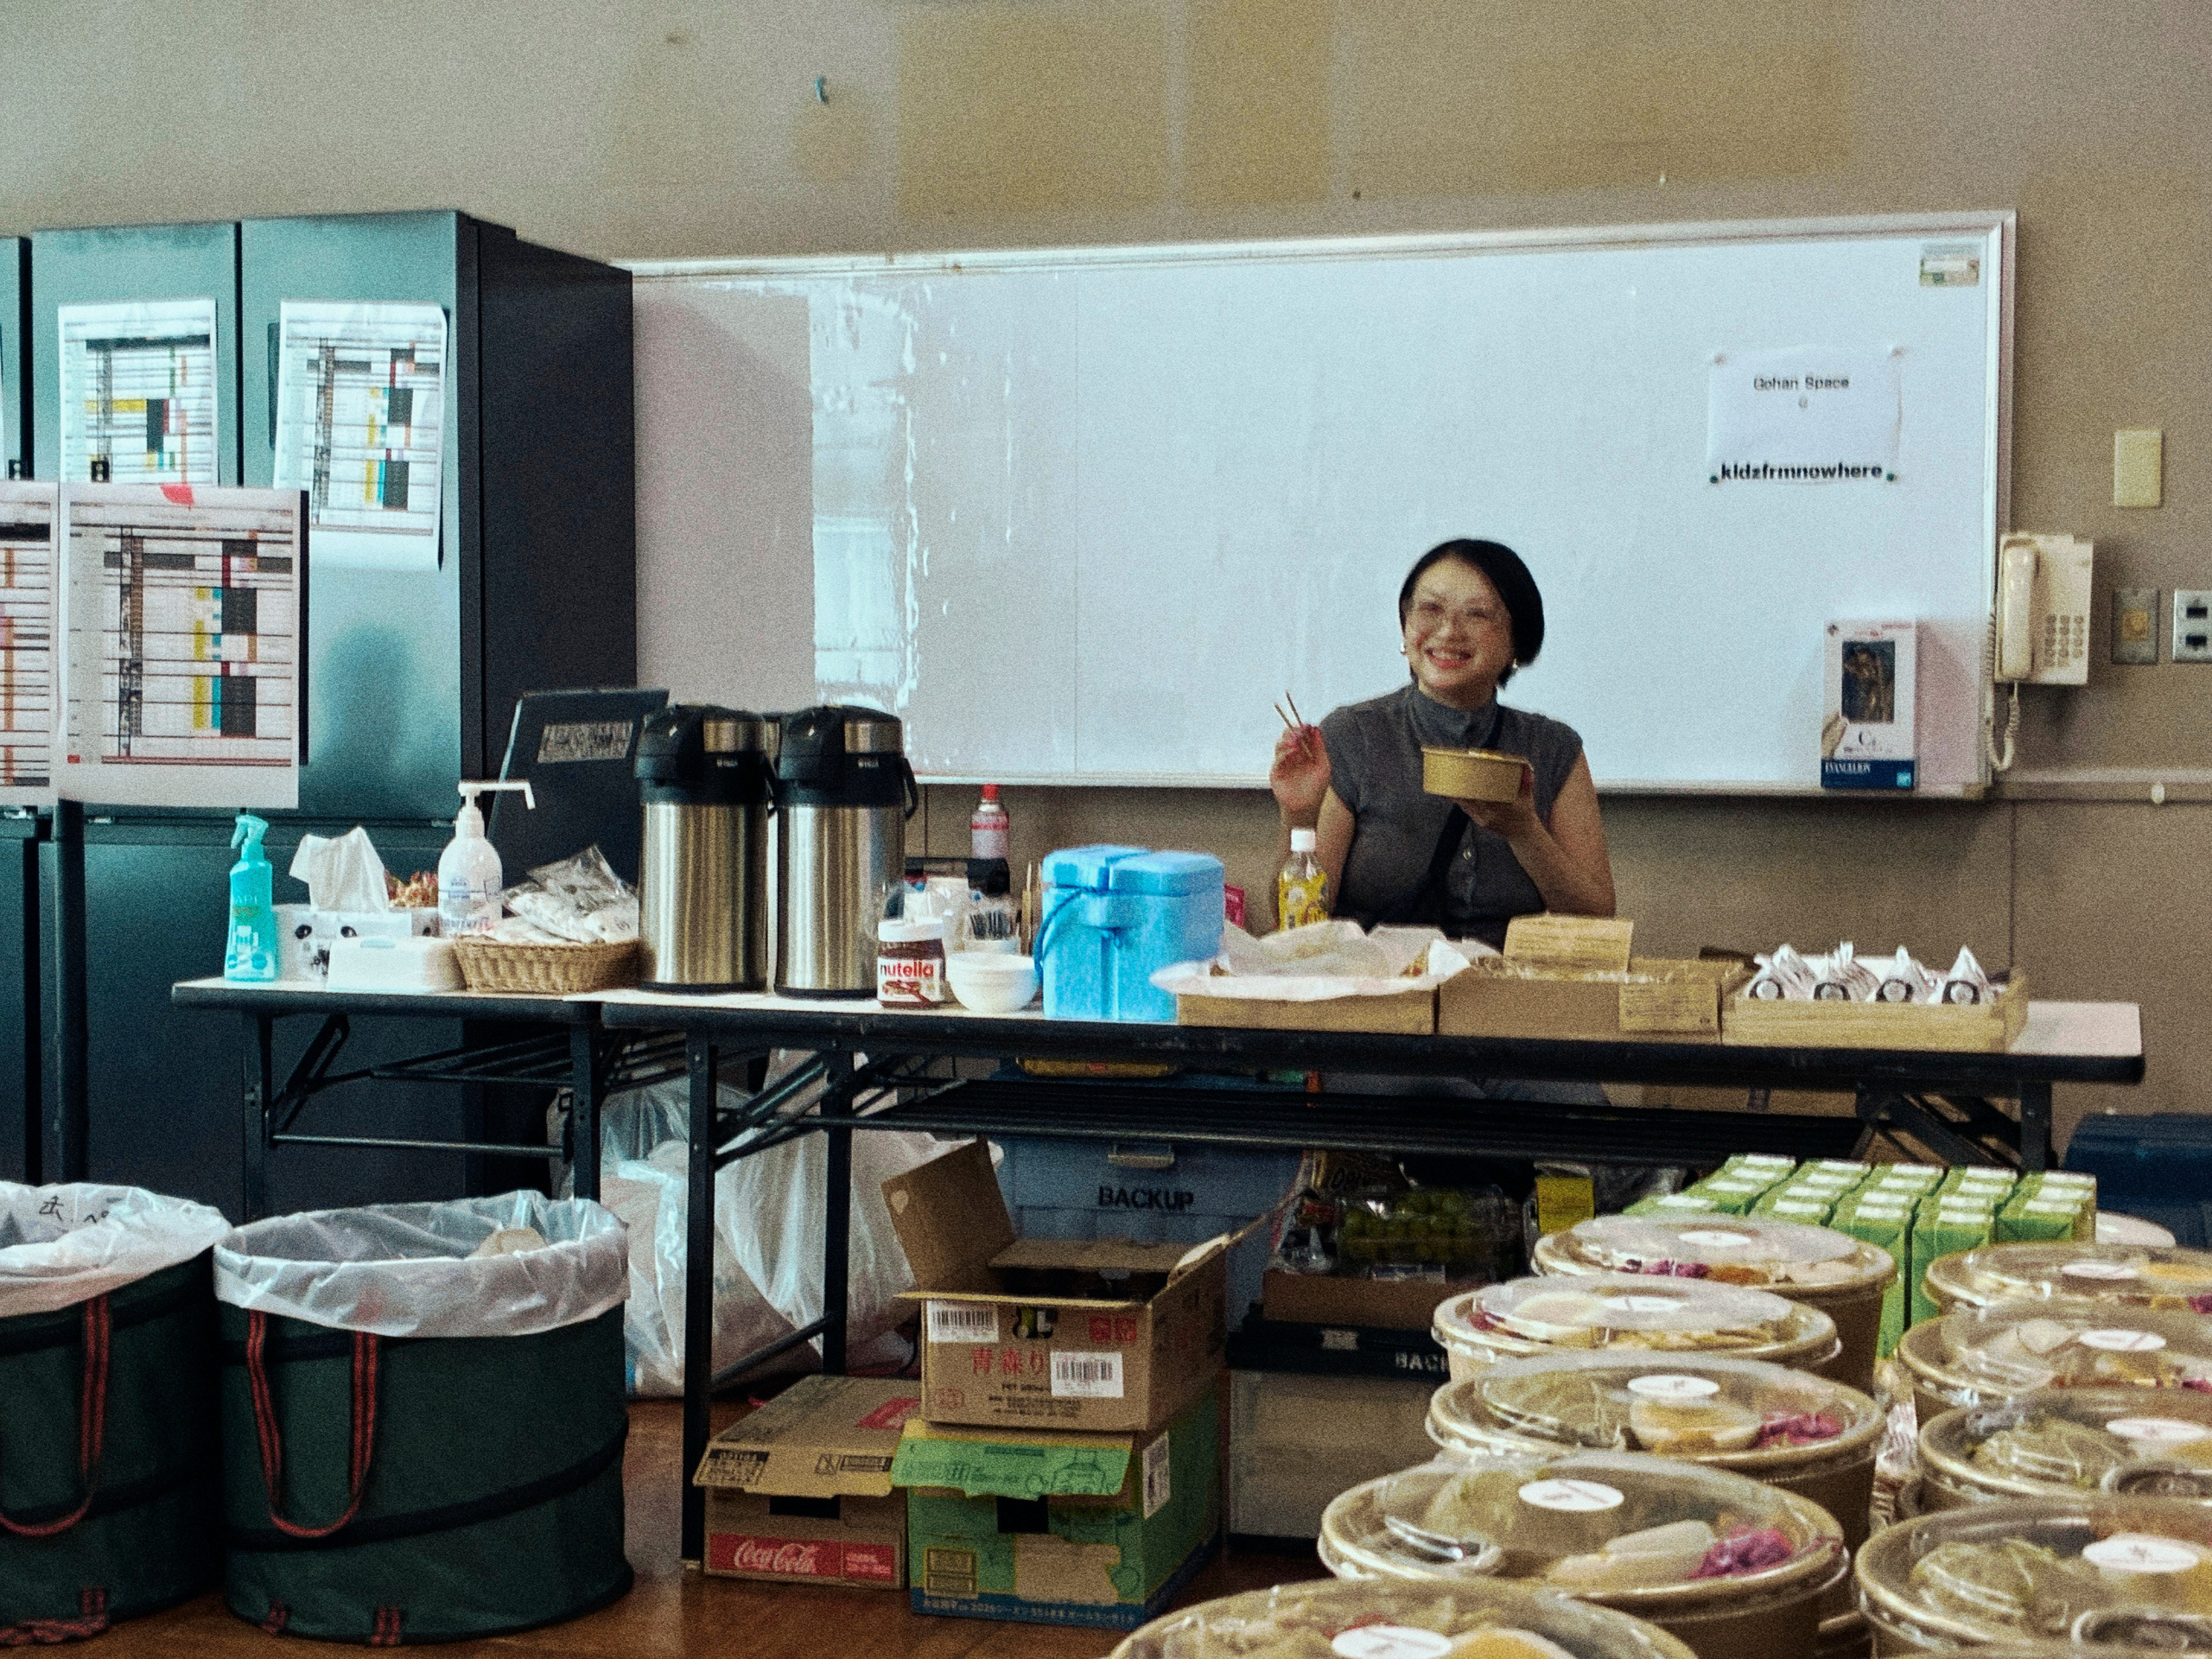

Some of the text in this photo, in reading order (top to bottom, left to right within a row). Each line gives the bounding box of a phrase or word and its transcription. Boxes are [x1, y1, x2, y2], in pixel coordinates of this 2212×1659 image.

[1753, 372, 1850, 391] Gohan Space
[880, 960, 934, 977] nutella
[1098, 1185, 1194, 1211] BACKUP
